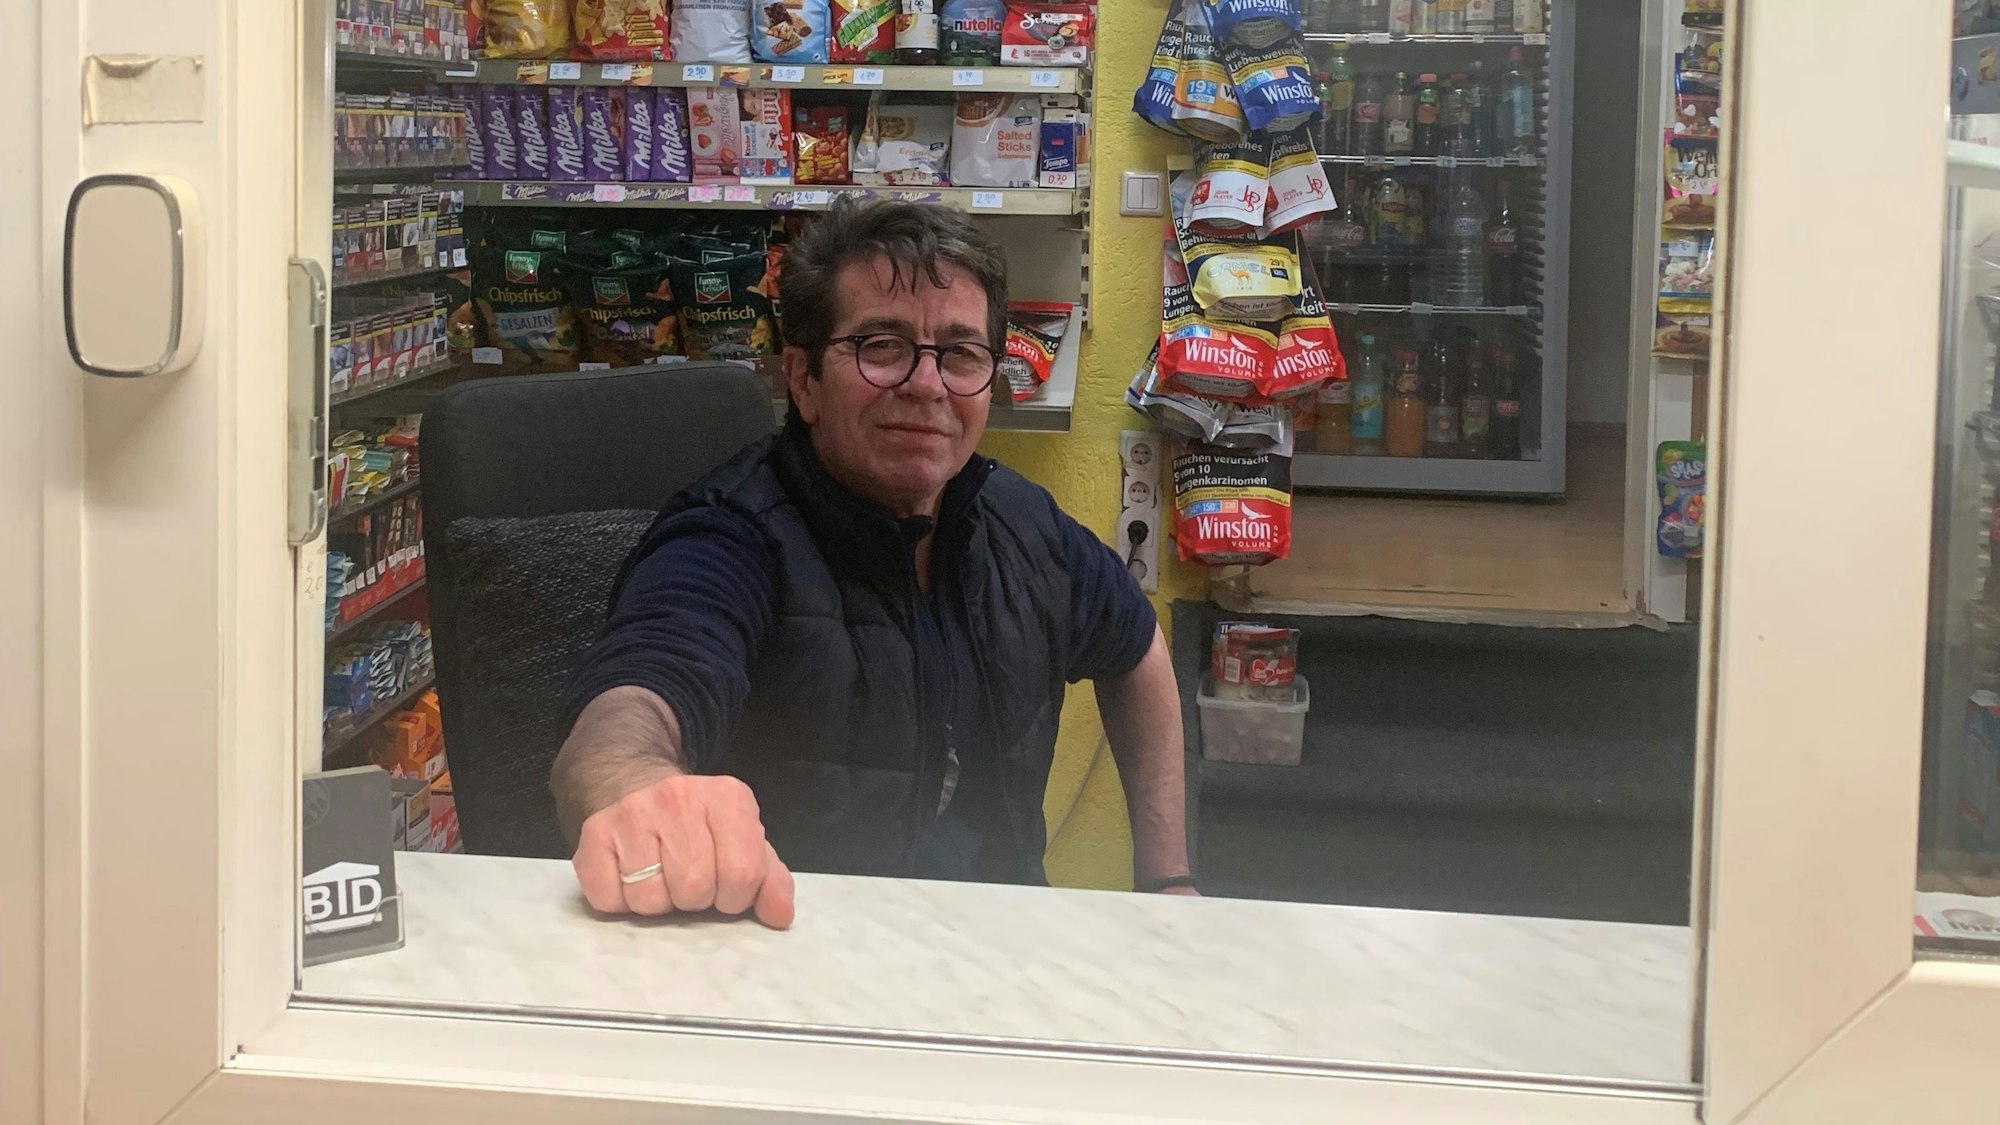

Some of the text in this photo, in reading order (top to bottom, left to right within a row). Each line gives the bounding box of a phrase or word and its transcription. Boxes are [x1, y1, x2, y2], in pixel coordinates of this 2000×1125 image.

[954, 19, 1001, 32] nutella
[488, 107, 516, 170] Milka
[518, 107, 547, 171] Milka
[551, 111, 583, 175] Milka
[586, 108, 619, 172] Milka
[629, 99, 651, 170] Milka
[658, 109, 686, 174] Milka
[997, 131, 1032, 140] Salted
[997, 142, 1031, 151] Sticks
[1043, 158, 1068, 168] Tempo
[514, 185, 547, 197] Milka
[655, 188, 687, 199] Milka
[1207, 262, 1271, 278] CAMEL
[1172, 295, 1189, 305] von
[1185, 338, 1257, 372] Winston
[1214, 454, 1269, 465] verursacht
[1199, 464, 1211, 474] 10
[1175, 476, 1268, 494] Lungenkarzinomen
[1197, 515, 1271, 540] Winston
[303, 876, 382, 922] BTD
